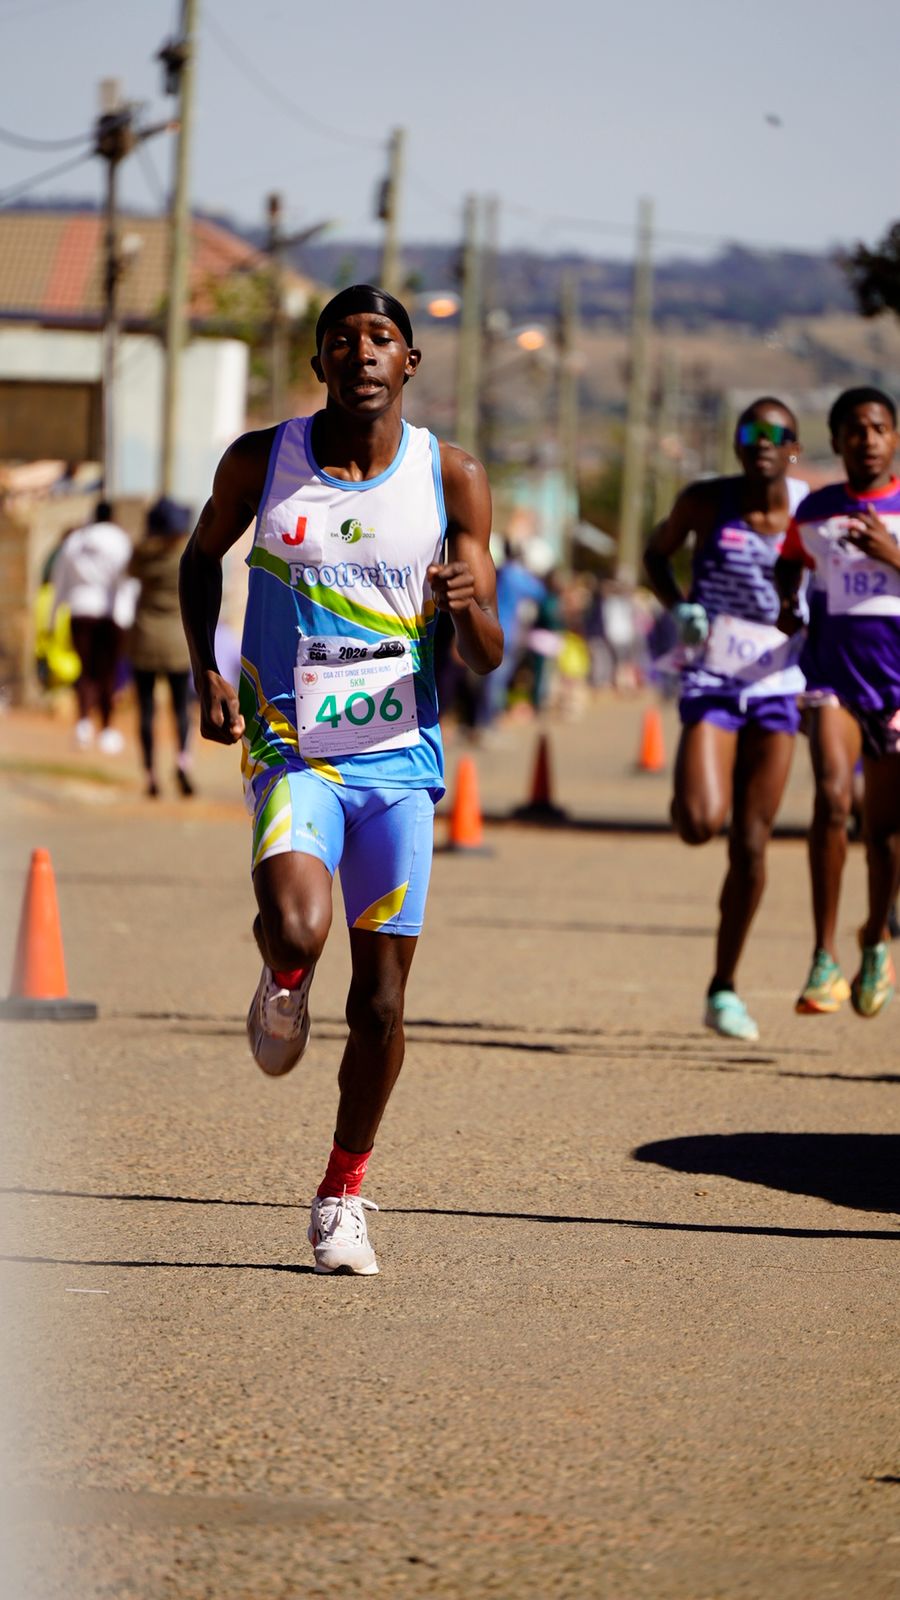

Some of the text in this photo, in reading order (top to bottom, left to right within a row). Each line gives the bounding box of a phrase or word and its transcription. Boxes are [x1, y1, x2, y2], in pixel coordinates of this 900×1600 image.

[281, 516, 307, 546] J
[843, 571, 887, 596] 182
[339, 647, 368, 660] 2026
[350, 678, 366, 688] 5KM
[316, 688, 403, 728] 406
